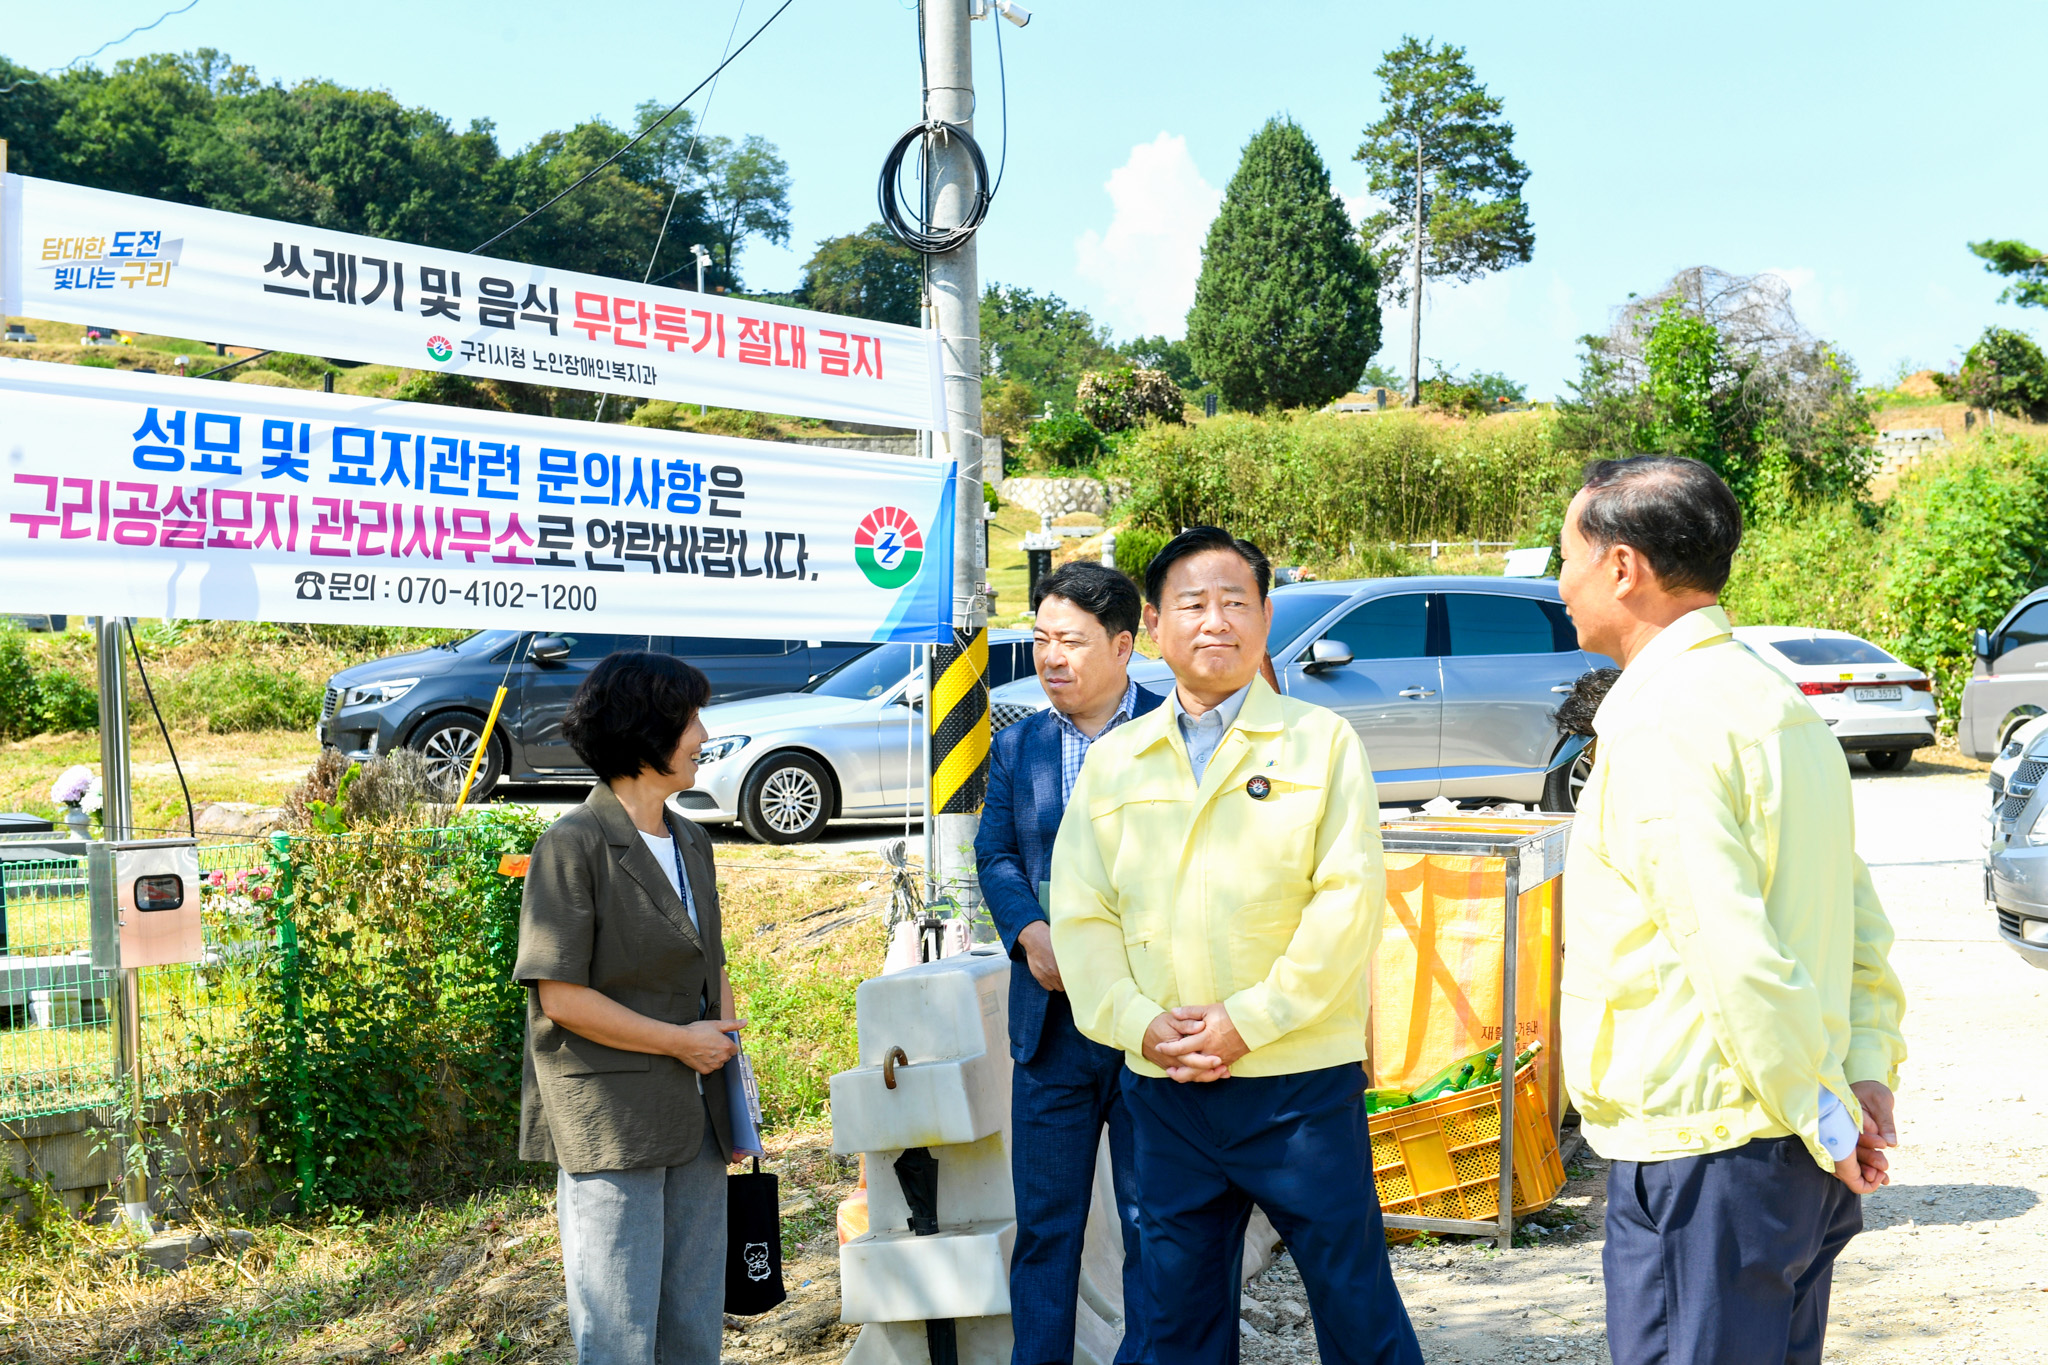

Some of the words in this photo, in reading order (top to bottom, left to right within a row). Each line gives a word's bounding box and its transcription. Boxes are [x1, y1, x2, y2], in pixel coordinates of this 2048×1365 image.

[41, 237, 105, 260] 담대한
[109, 231, 161, 258] 도전
[54, 266, 116, 290] 빛나는
[120, 262, 172, 288] 구리
[264, 242, 403, 312] 쓰레기
[420, 267, 461, 321] 및
[478, 277, 558, 336] 음식
[573, 291, 726, 358] 무단투기
[738, 317, 807, 370] 절대
[818, 329, 883, 379] 금지
[461, 341, 526, 369] 구리시청
[533, 350, 657, 386] 노인장애인복지과
[132, 407, 242, 475] 성묘
[261, 419, 311, 482] 및
[329, 427, 520, 500] 묘지관련
[537, 448, 745, 518] 문의사항은
[10, 473, 299, 552] 구리공설묘지
[310, 497, 577, 567] 관리사무소로
[585, 519, 819, 581] 연락바랍니다.
[328, 573, 376, 601] 문의
[397, 577, 597, 611] 070-4102-1200
